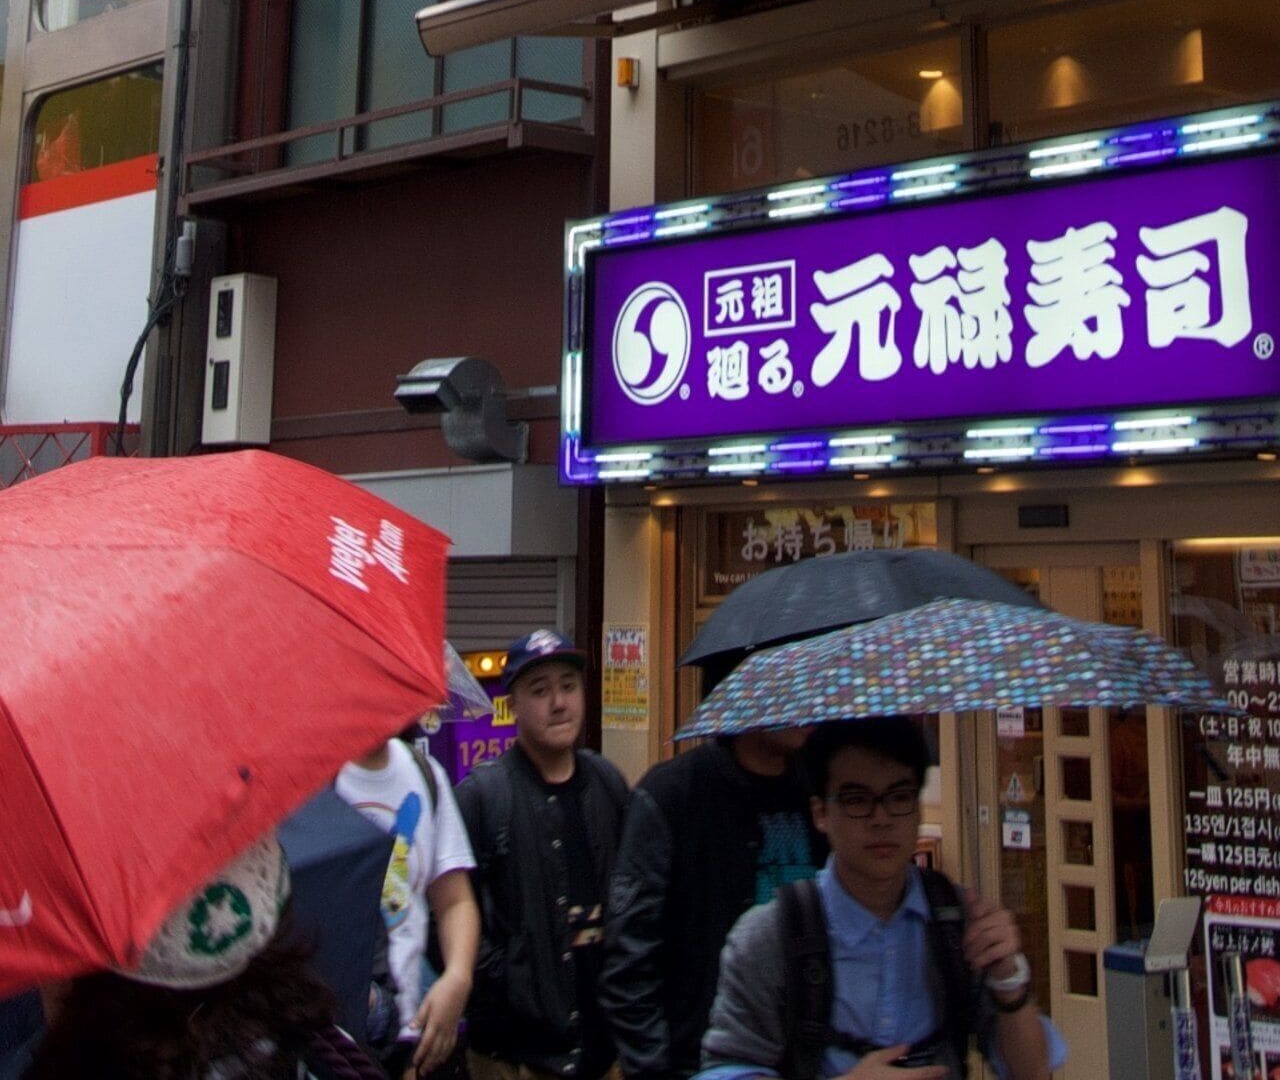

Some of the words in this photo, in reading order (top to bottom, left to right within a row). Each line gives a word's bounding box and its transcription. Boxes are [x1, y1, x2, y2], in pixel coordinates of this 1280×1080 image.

[715, 274, 784, 325] 元祖
[810, 205, 1253, 387] 元禄寿司
[1230, 877, 1252, 893] per
[1253, 874, 1280, 896] dish
